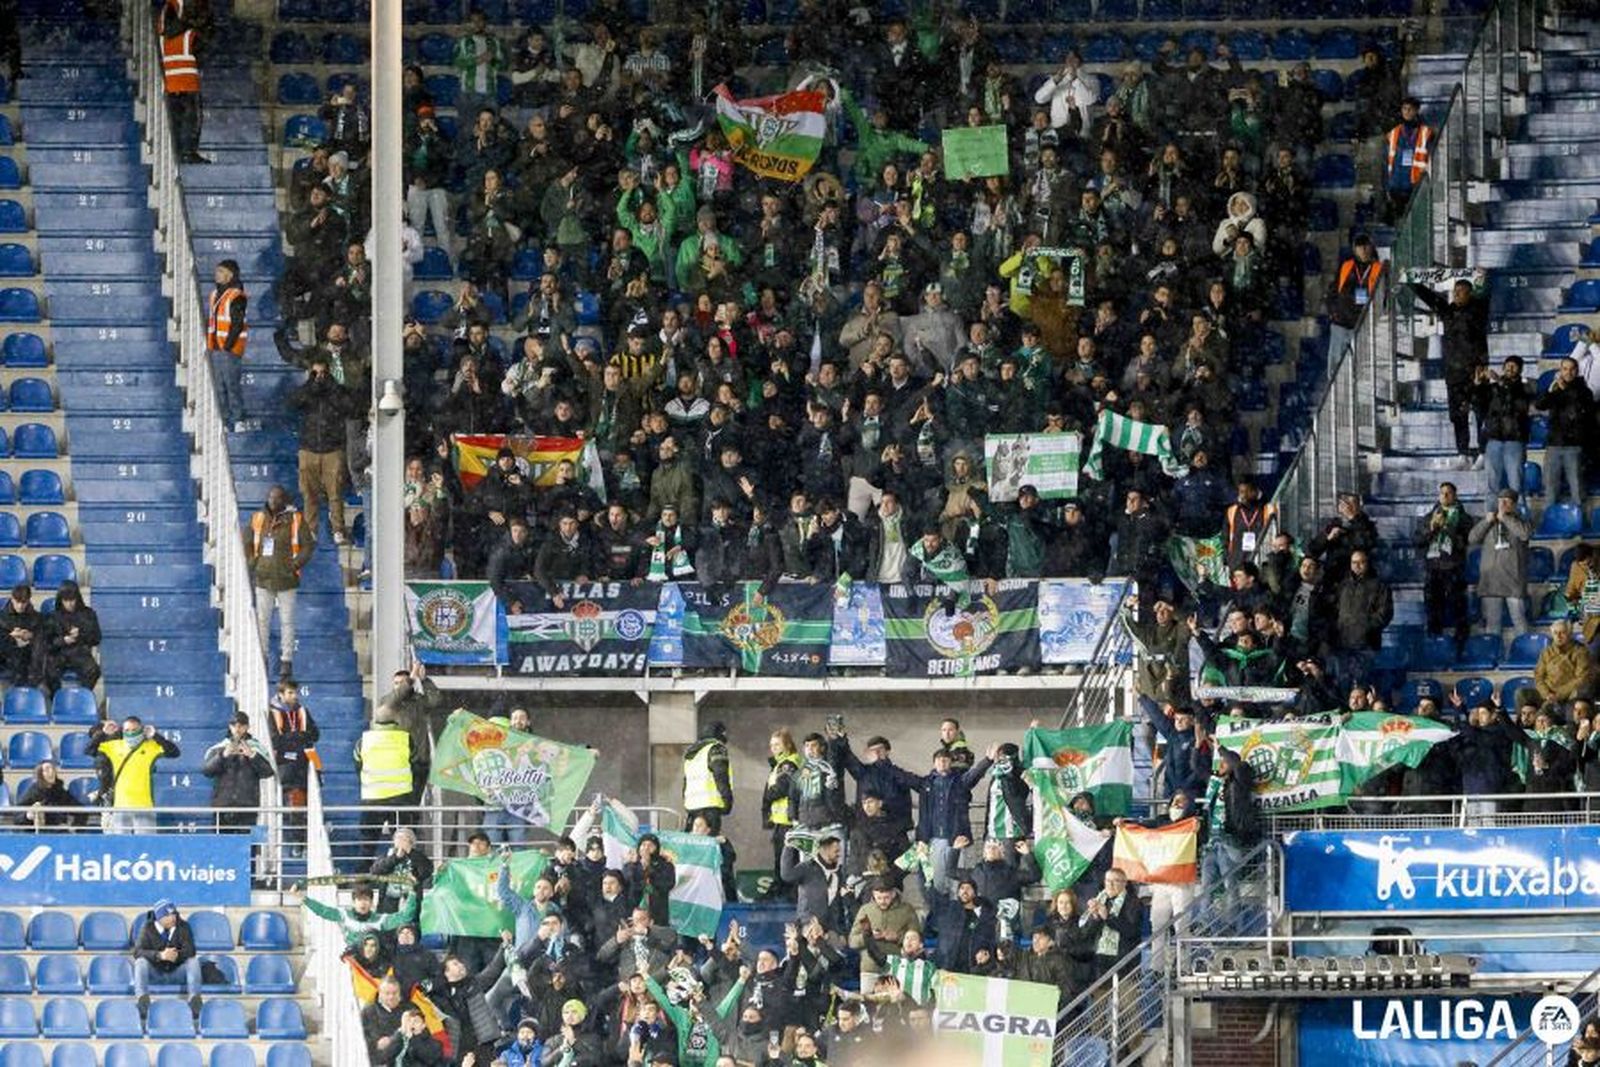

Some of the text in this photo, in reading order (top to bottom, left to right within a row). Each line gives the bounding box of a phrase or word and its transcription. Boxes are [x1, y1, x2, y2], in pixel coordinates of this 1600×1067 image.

[79, 195, 97, 206] 27
[207, 196, 224, 207] 27
[86, 239, 104, 249] 26
[213, 239, 231, 250] 26
[92, 283, 110, 294] 25
[99, 329, 117, 340] 24
[104, 373, 123, 384] 23
[112, 419, 131, 430] 22
[118, 464, 137, 476] 21
[250, 464, 268, 476] 21
[127, 511, 145, 522] 20
[135, 554, 153, 565] 19
[142, 597, 159, 607] 18
[684, 591, 731, 607] PILS
[149, 640, 167, 651] 17
[520, 653, 647, 673] AWAYDAYS
[928, 659, 964, 675] BETIS
[156, 686, 174, 697] 16
[171, 775, 190, 787] 14
[55, 853, 236, 884] Halcón viajes
[1435, 855, 1600, 897] kutxaba
[938, 1011, 1053, 1037] ZAGRA
